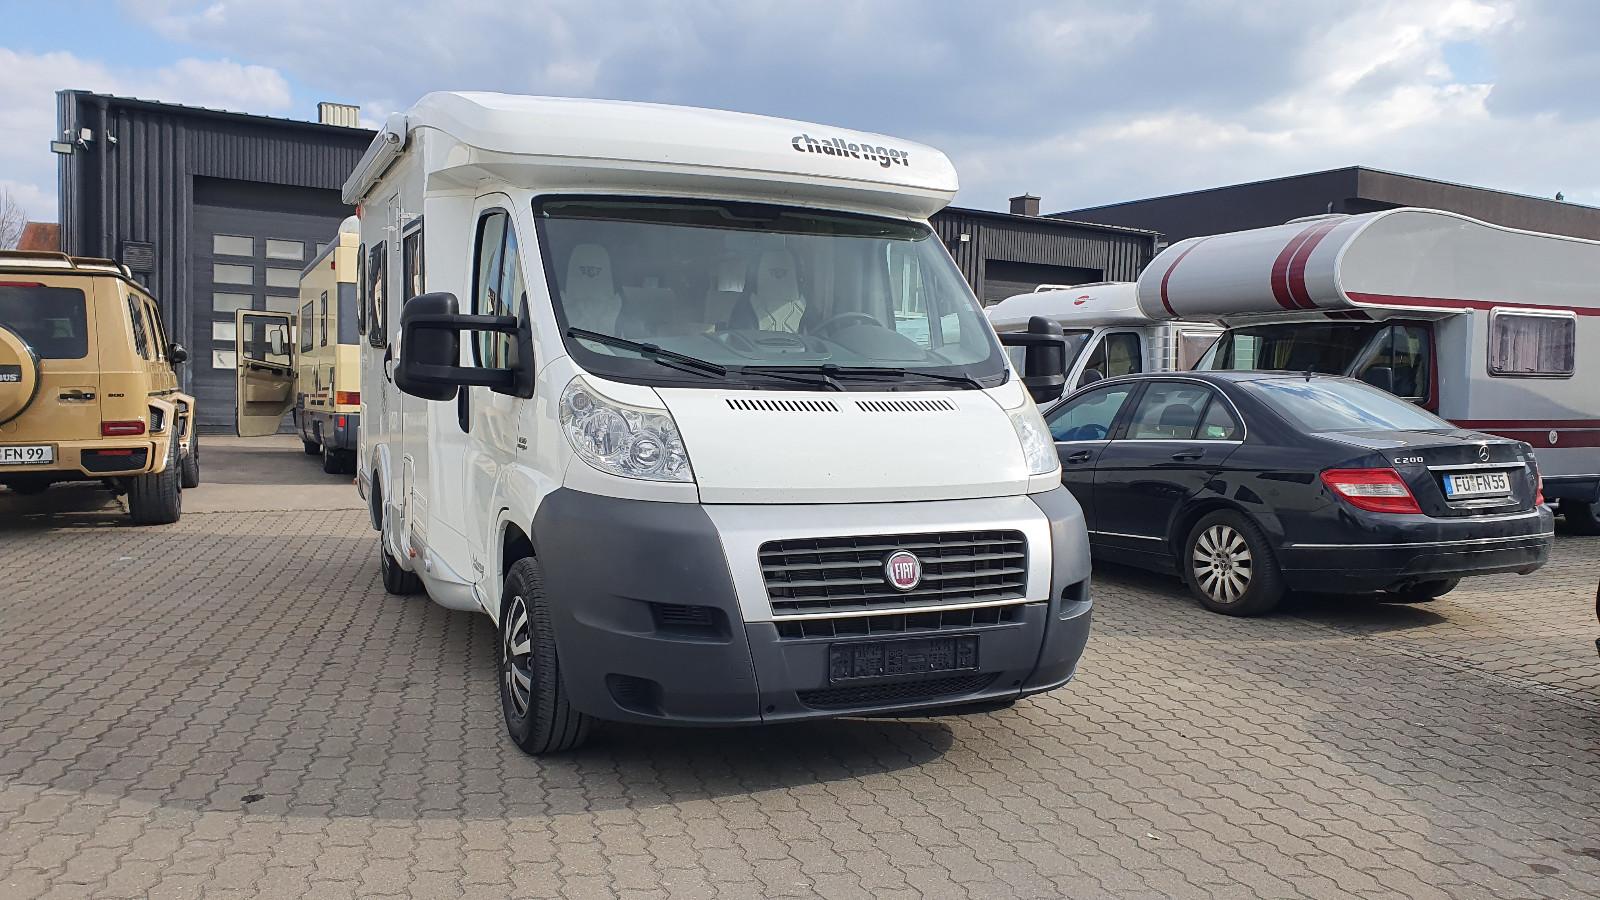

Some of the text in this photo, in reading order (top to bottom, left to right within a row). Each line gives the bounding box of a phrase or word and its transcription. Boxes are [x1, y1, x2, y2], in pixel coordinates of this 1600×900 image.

[791, 133, 909, 169] challenger
[4, 448, 44, 460] FN 99
[894, 562, 914, 580] FIAT
